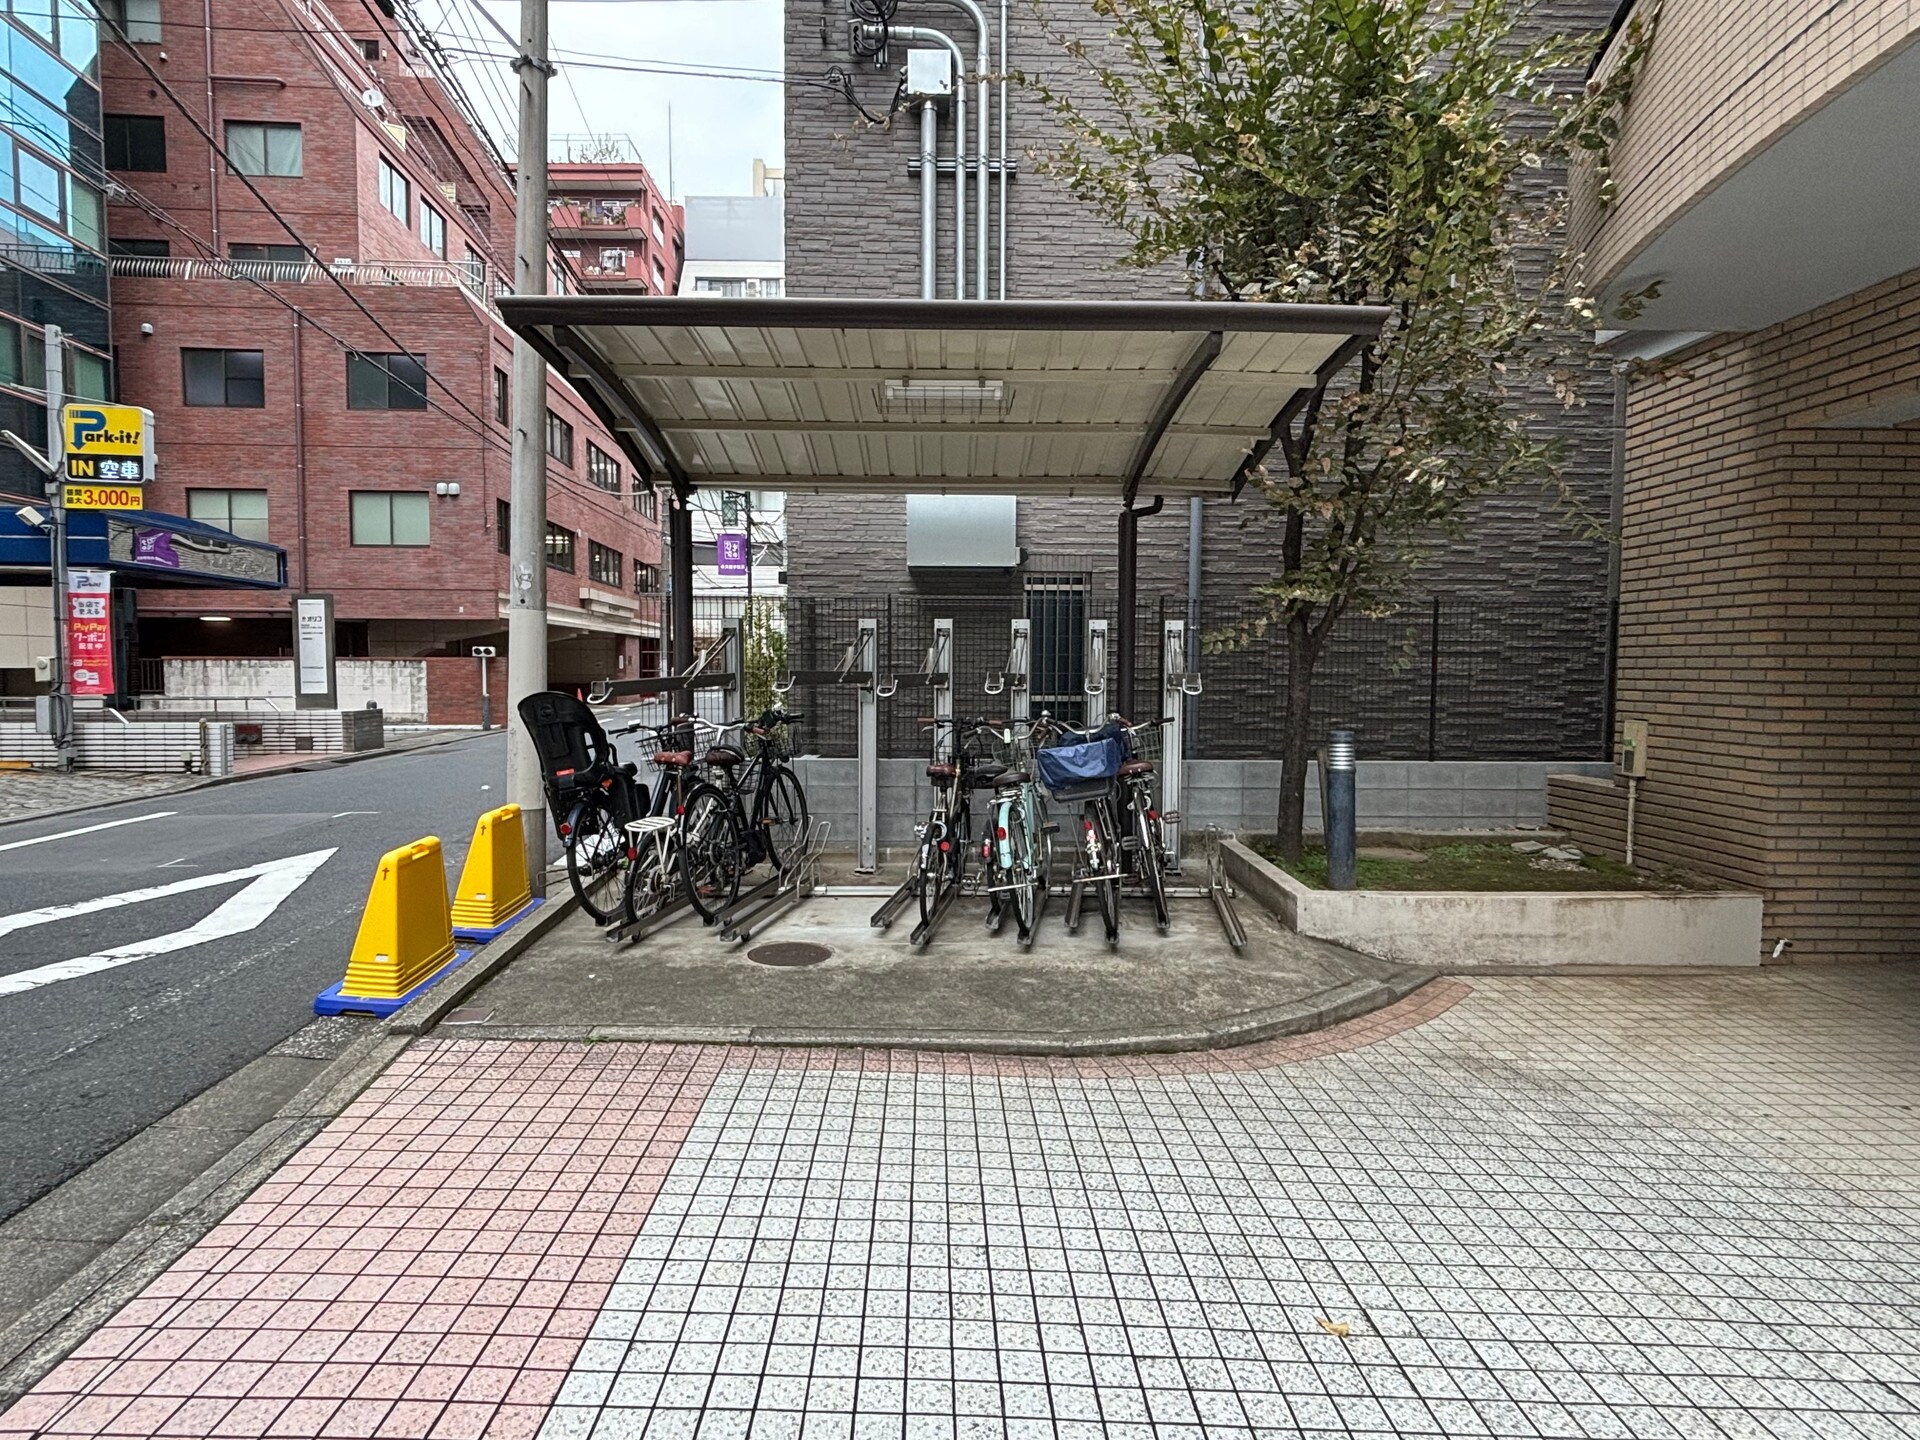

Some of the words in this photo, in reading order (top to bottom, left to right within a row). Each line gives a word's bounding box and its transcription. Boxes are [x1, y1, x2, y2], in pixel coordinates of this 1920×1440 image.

[69, 410, 140, 450] Park-it!
[71, 460, 94, 476] IN
[99, 460, 140, 479] 空車
[83, 489, 140, 506] 3,000円
[73, 622, 107, 632] PayPay
[73, 632, 106, 642] クーポン
